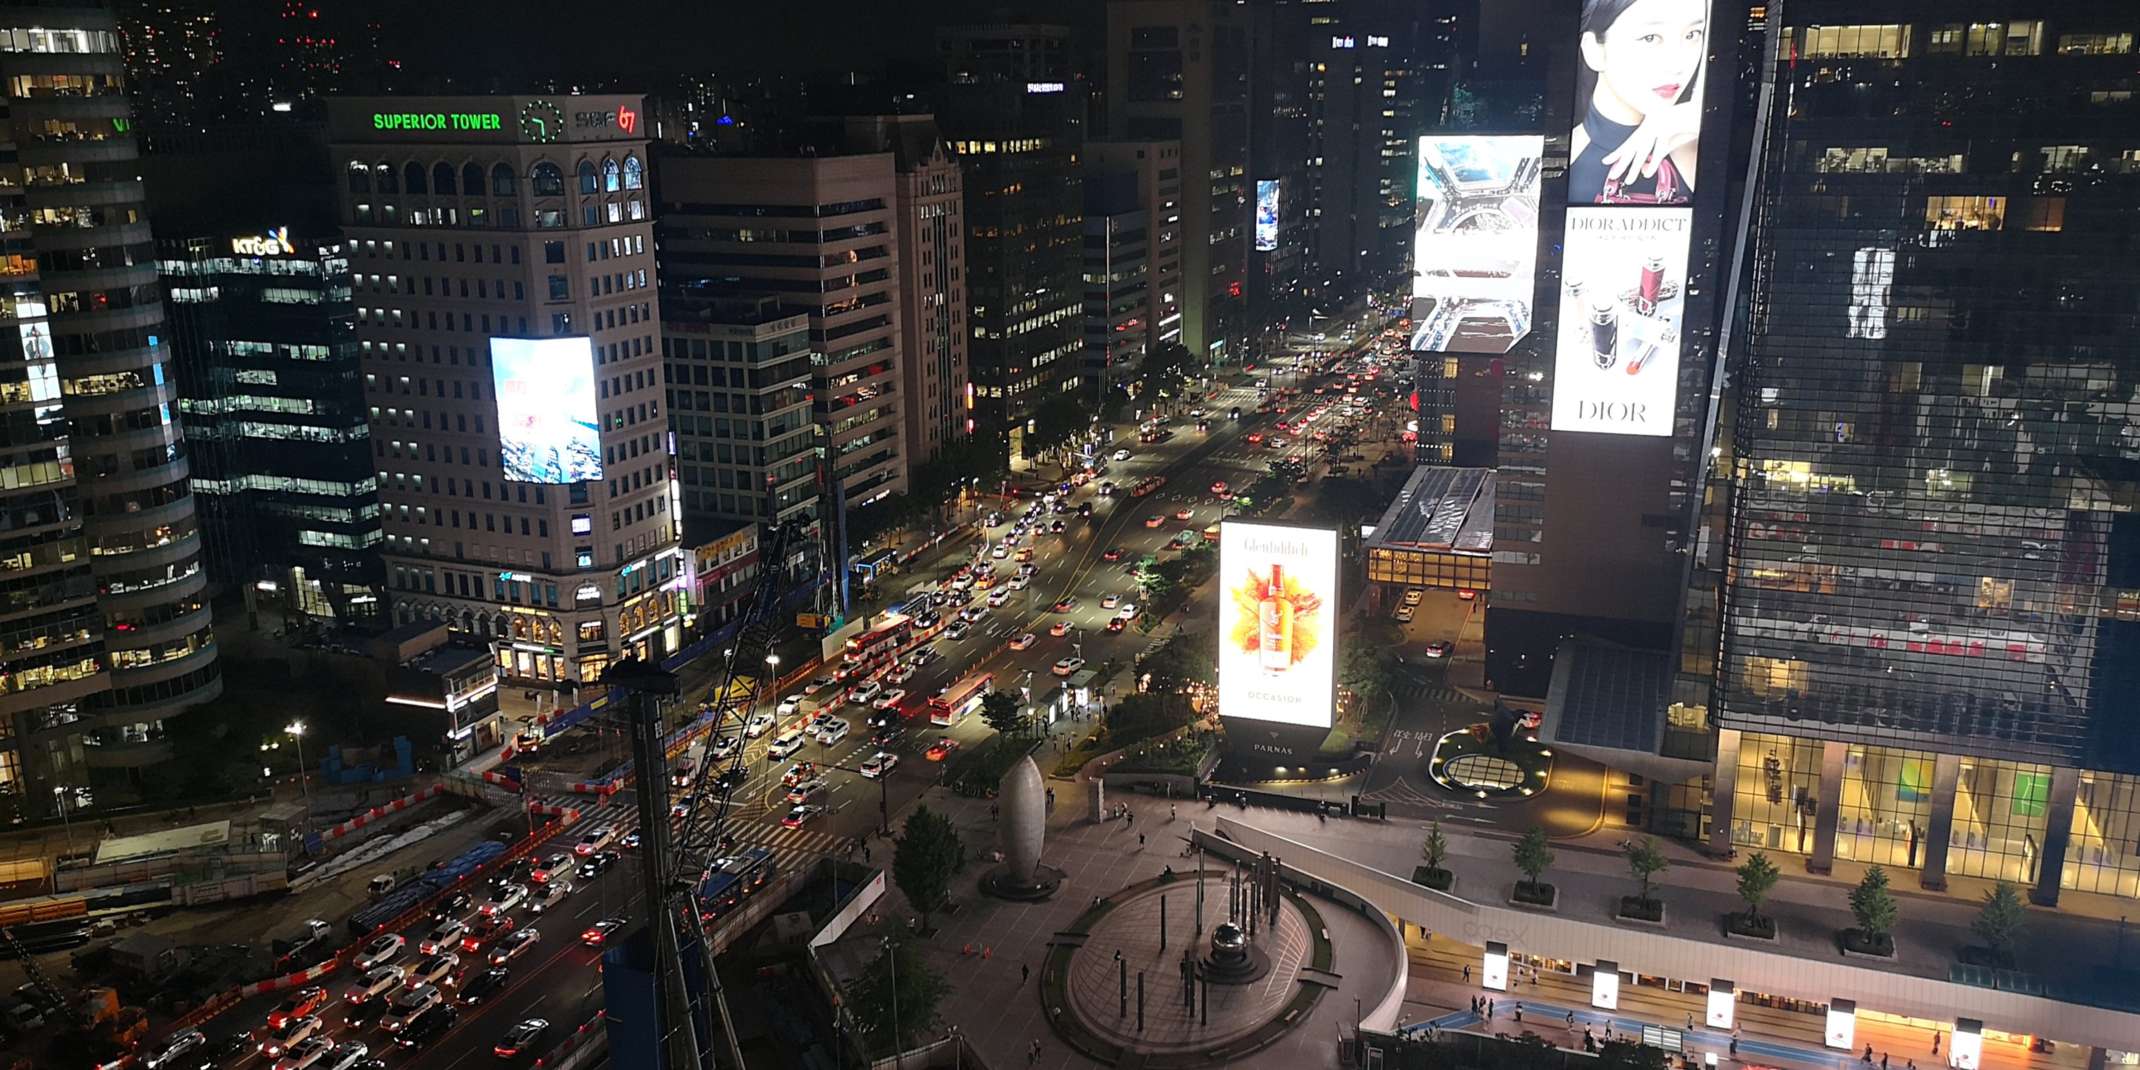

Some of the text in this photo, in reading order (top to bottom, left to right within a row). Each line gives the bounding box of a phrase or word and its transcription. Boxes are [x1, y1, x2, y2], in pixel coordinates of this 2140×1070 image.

[374, 113, 501, 130] SUPERIOR TOWER
[1571, 217, 1687, 232] DIOR ADDICT
[232, 236, 279, 256] KT&G
[1579, 400, 1646, 423] DIOR
[1254, 744, 1292, 755] PARNAS
